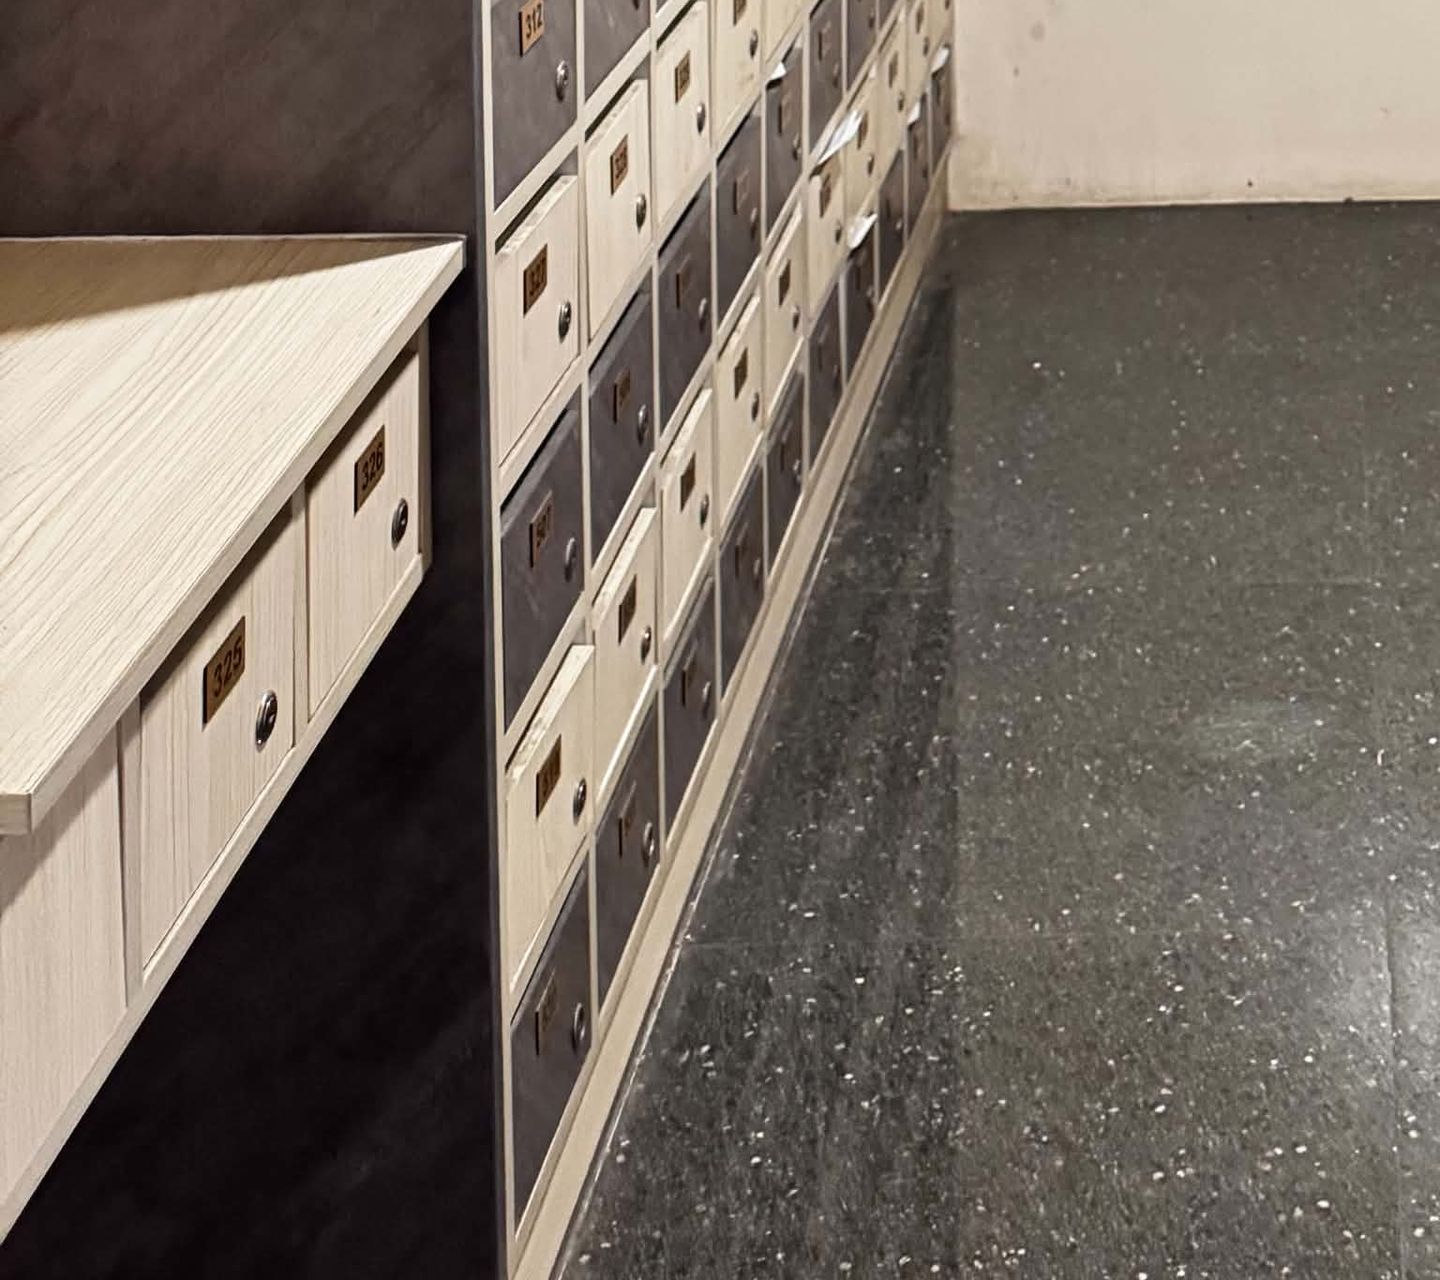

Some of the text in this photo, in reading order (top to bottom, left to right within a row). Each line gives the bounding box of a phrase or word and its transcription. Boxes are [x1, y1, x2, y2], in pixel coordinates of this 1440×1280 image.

[526, 3, 543, 39] 312
[362, 441, 383, 491] 326
[214, 636, 243, 698] 325
